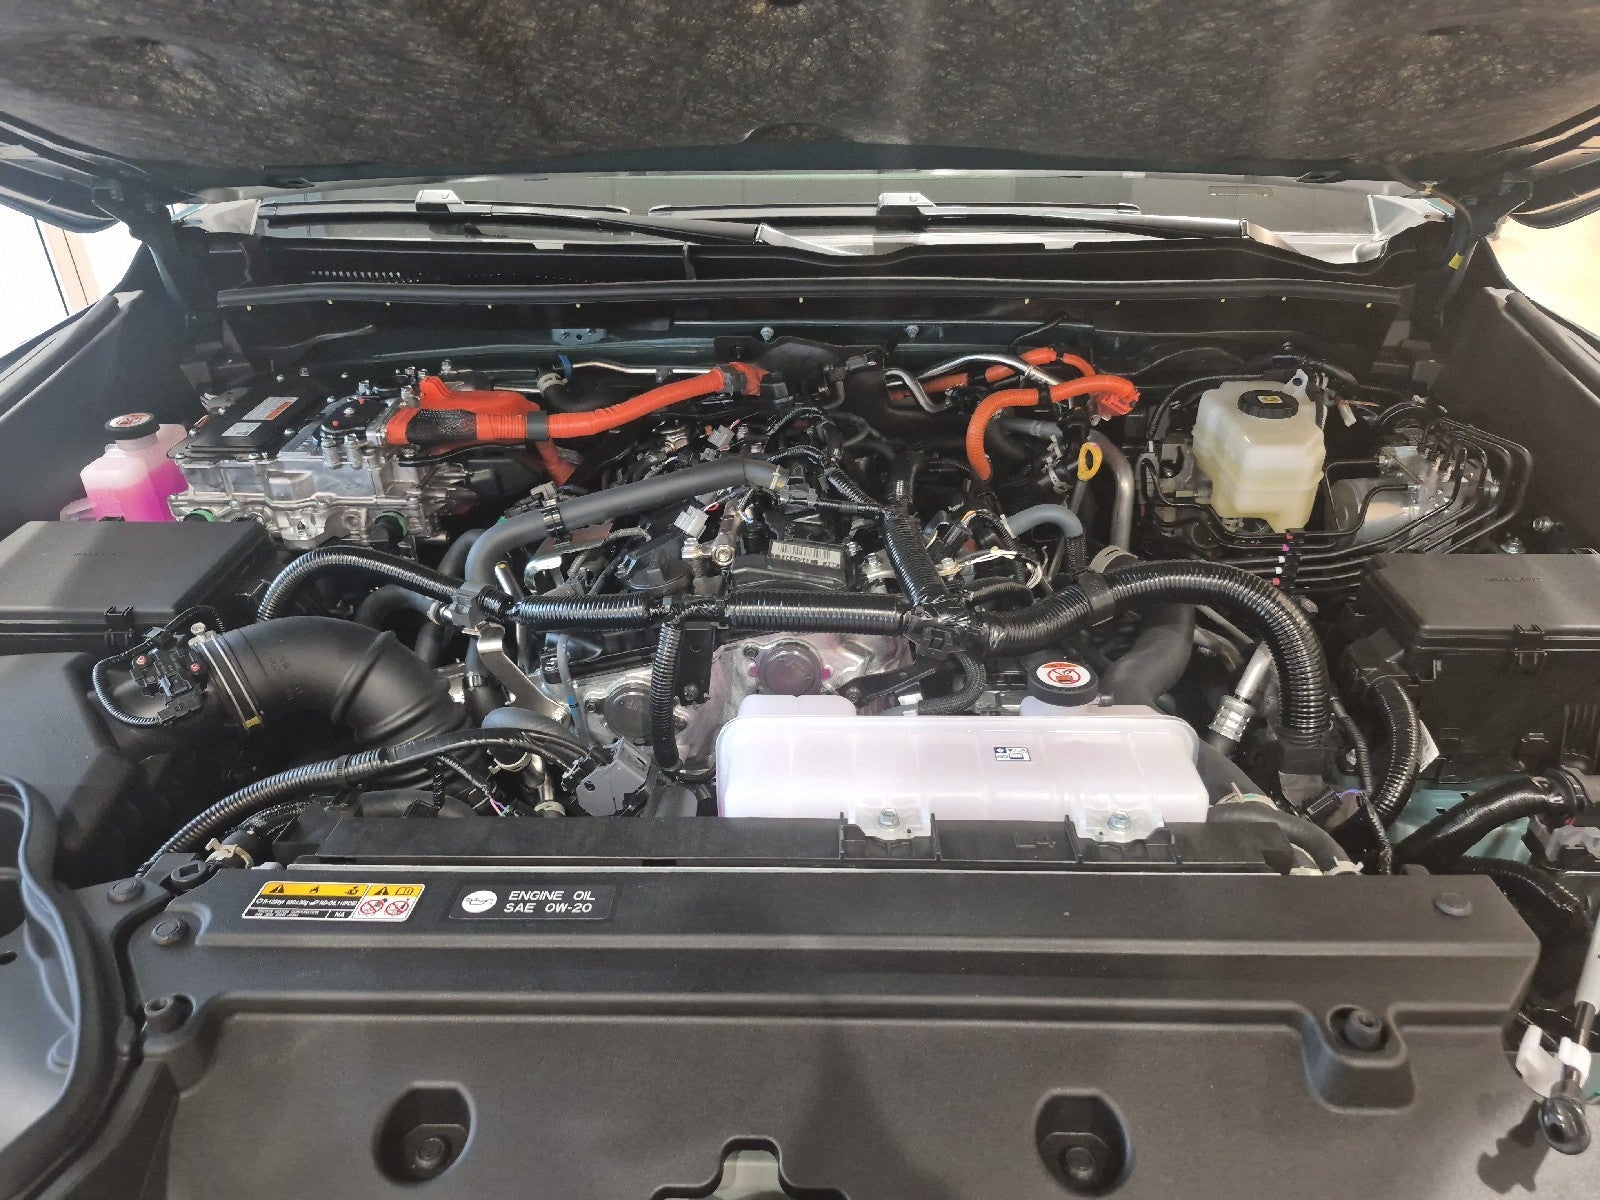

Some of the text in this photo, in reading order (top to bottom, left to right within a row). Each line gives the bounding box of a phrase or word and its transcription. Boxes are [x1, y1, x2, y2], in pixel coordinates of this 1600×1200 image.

[508, 890, 596, 901] ENGINE OIL
[503, 902, 593, 913] SAE 0W-20
